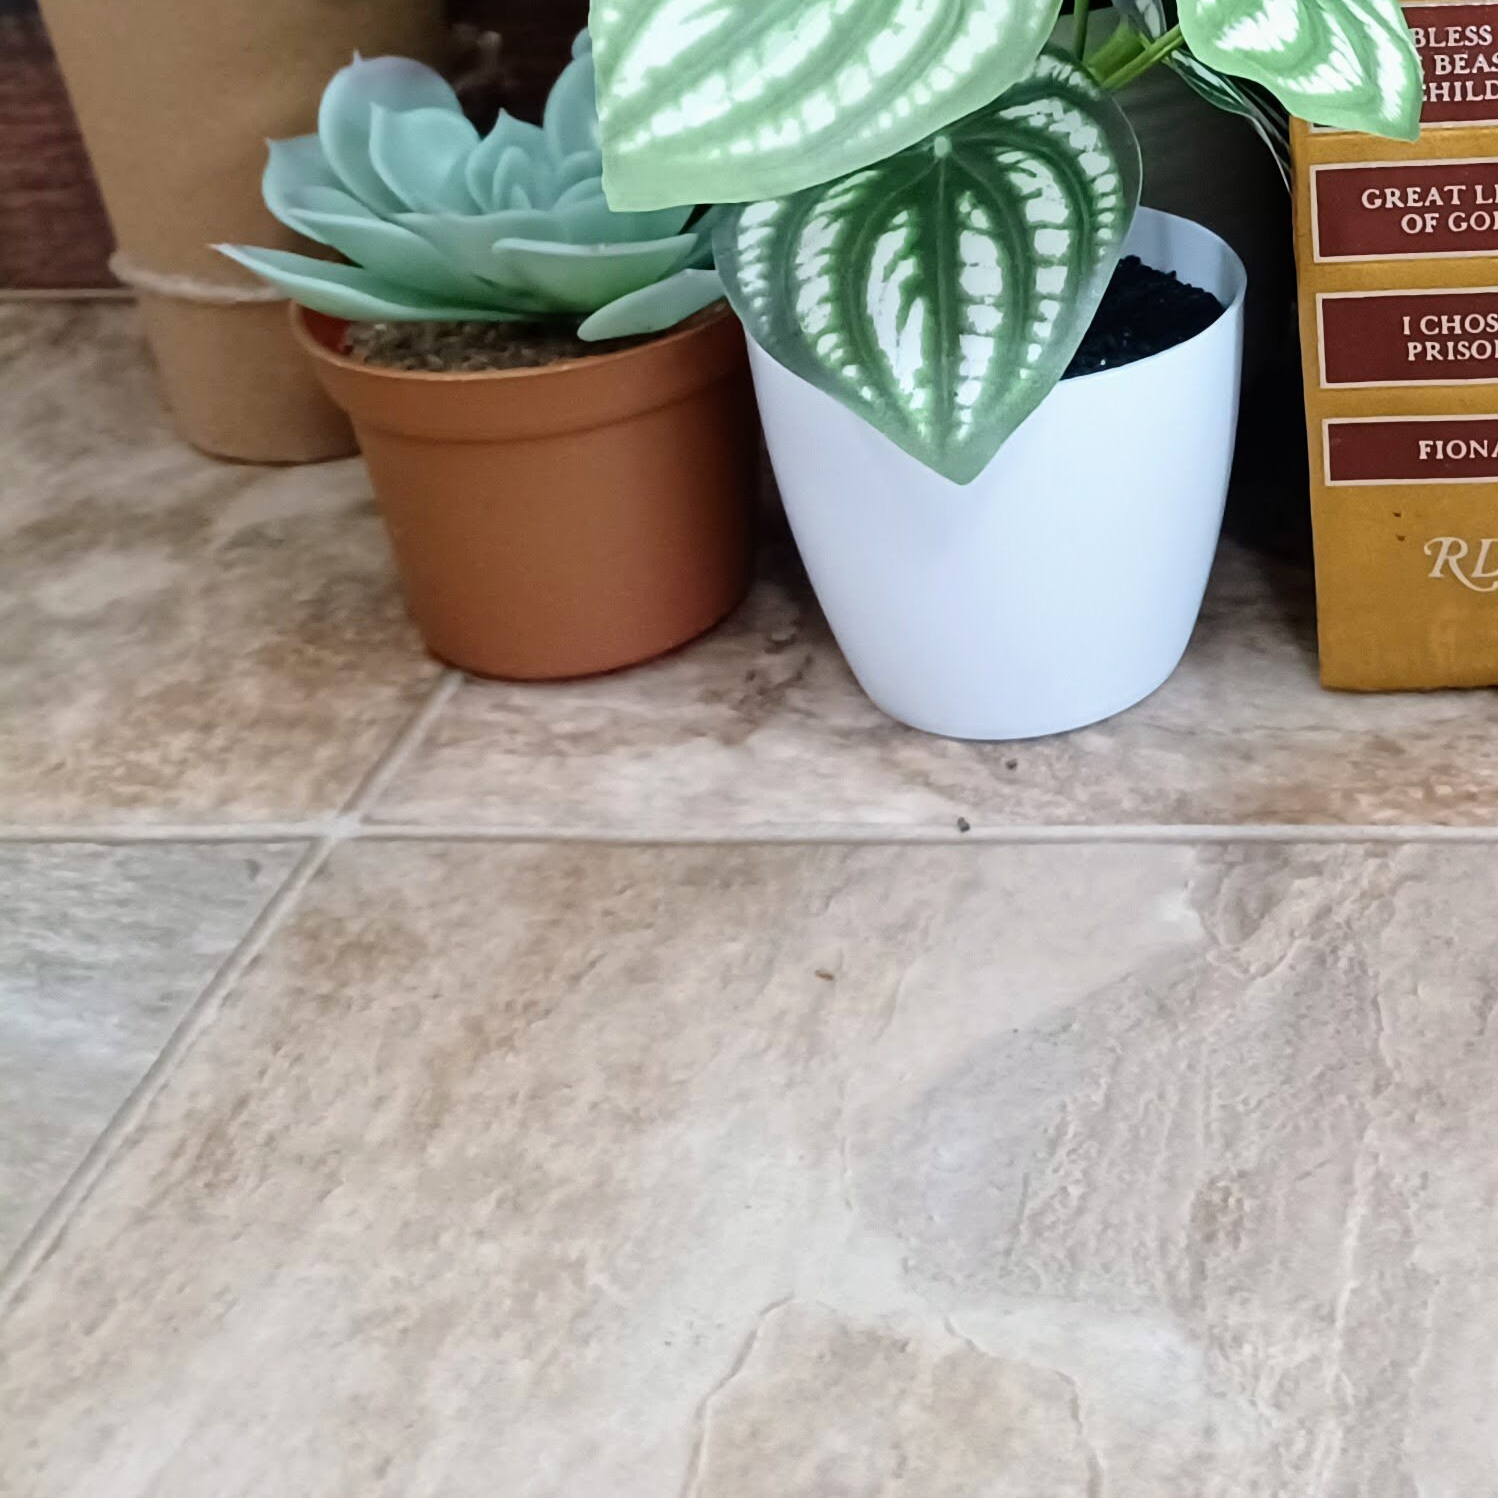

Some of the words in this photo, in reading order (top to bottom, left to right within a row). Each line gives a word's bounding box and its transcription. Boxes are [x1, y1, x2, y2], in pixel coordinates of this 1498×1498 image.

[1411, 25, 1493, 48] BLESS
[1361, 185, 1467, 210] GREAT
[1400, 213, 1441, 234] OF
[1402, 316, 1411, 336] I
